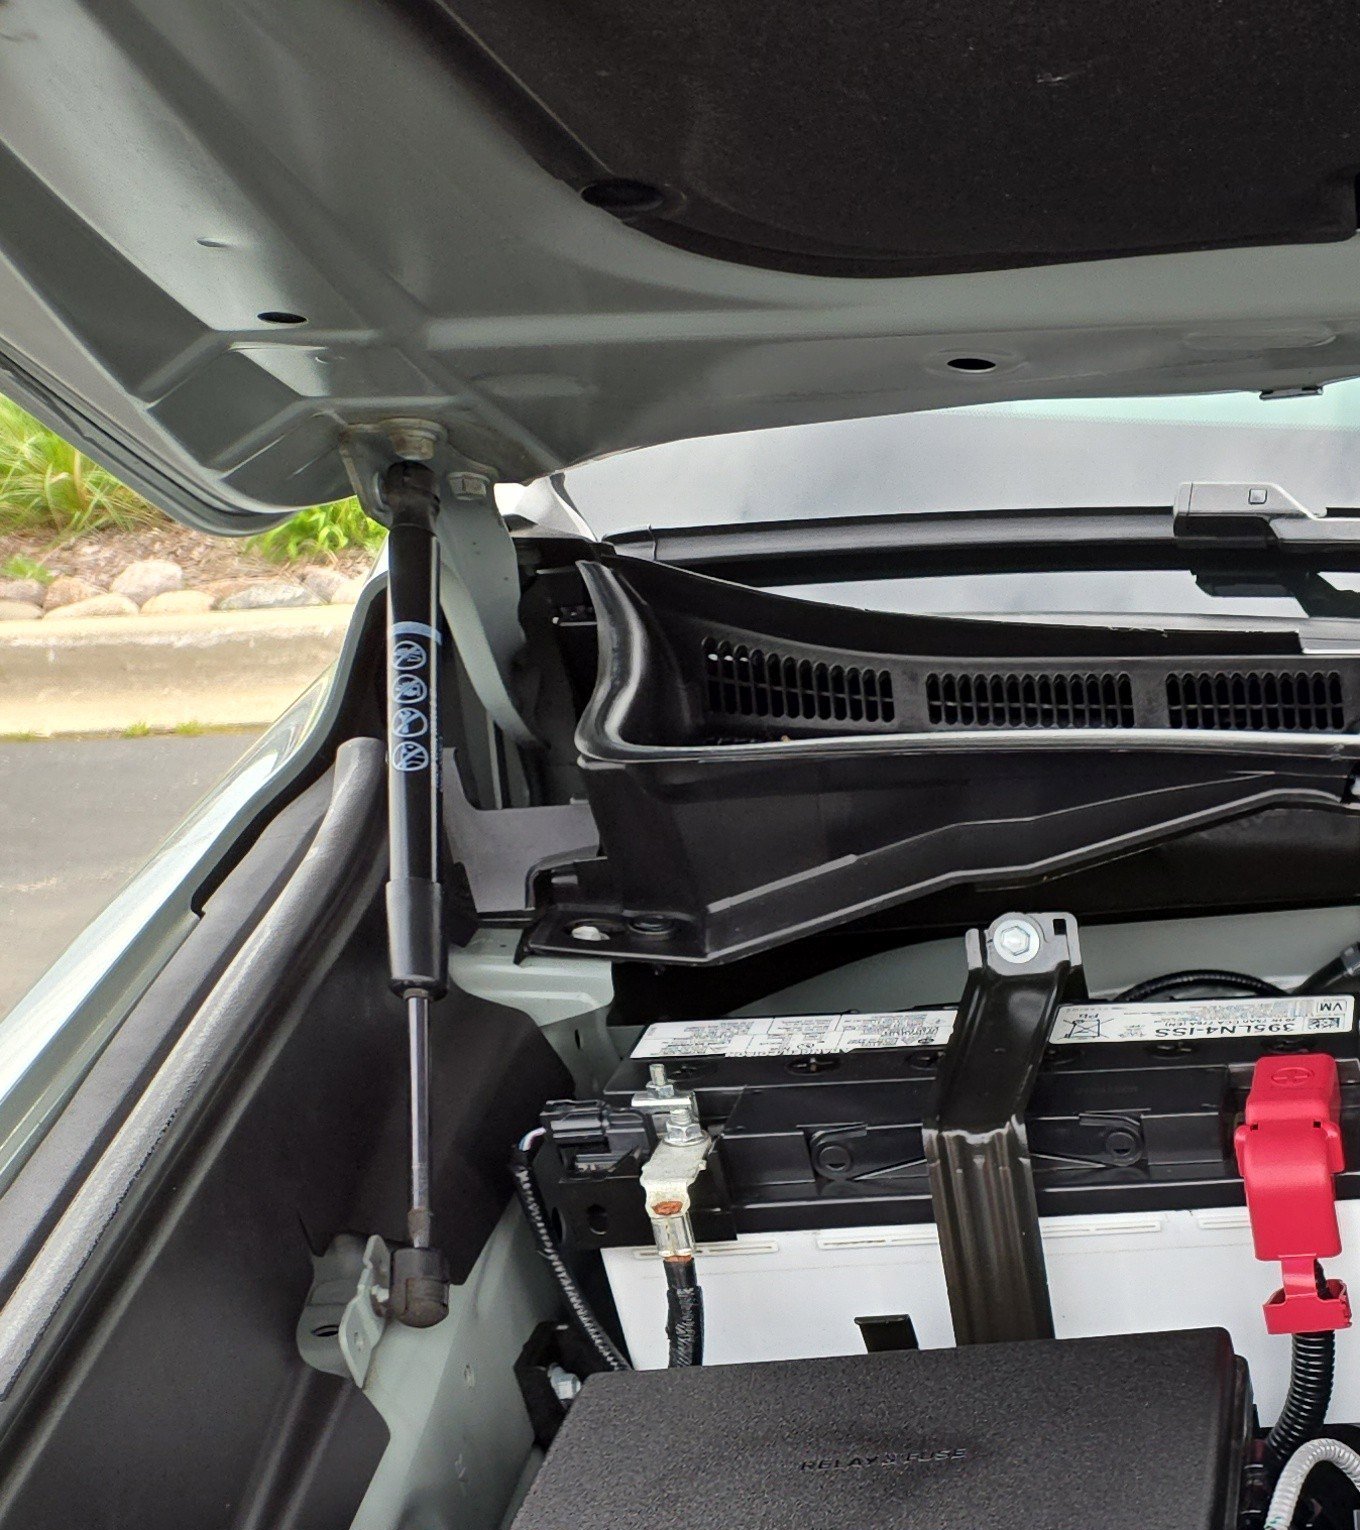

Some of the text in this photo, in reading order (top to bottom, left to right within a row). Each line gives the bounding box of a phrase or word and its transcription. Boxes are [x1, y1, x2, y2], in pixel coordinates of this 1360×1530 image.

[1319, 1001, 1343, 1012] VM
[1155, 1022, 1296, 1038] 395LN4-ISS
[800, 1454, 879, 1471] RELAY
[903, 1448, 967, 1465] FUSE
